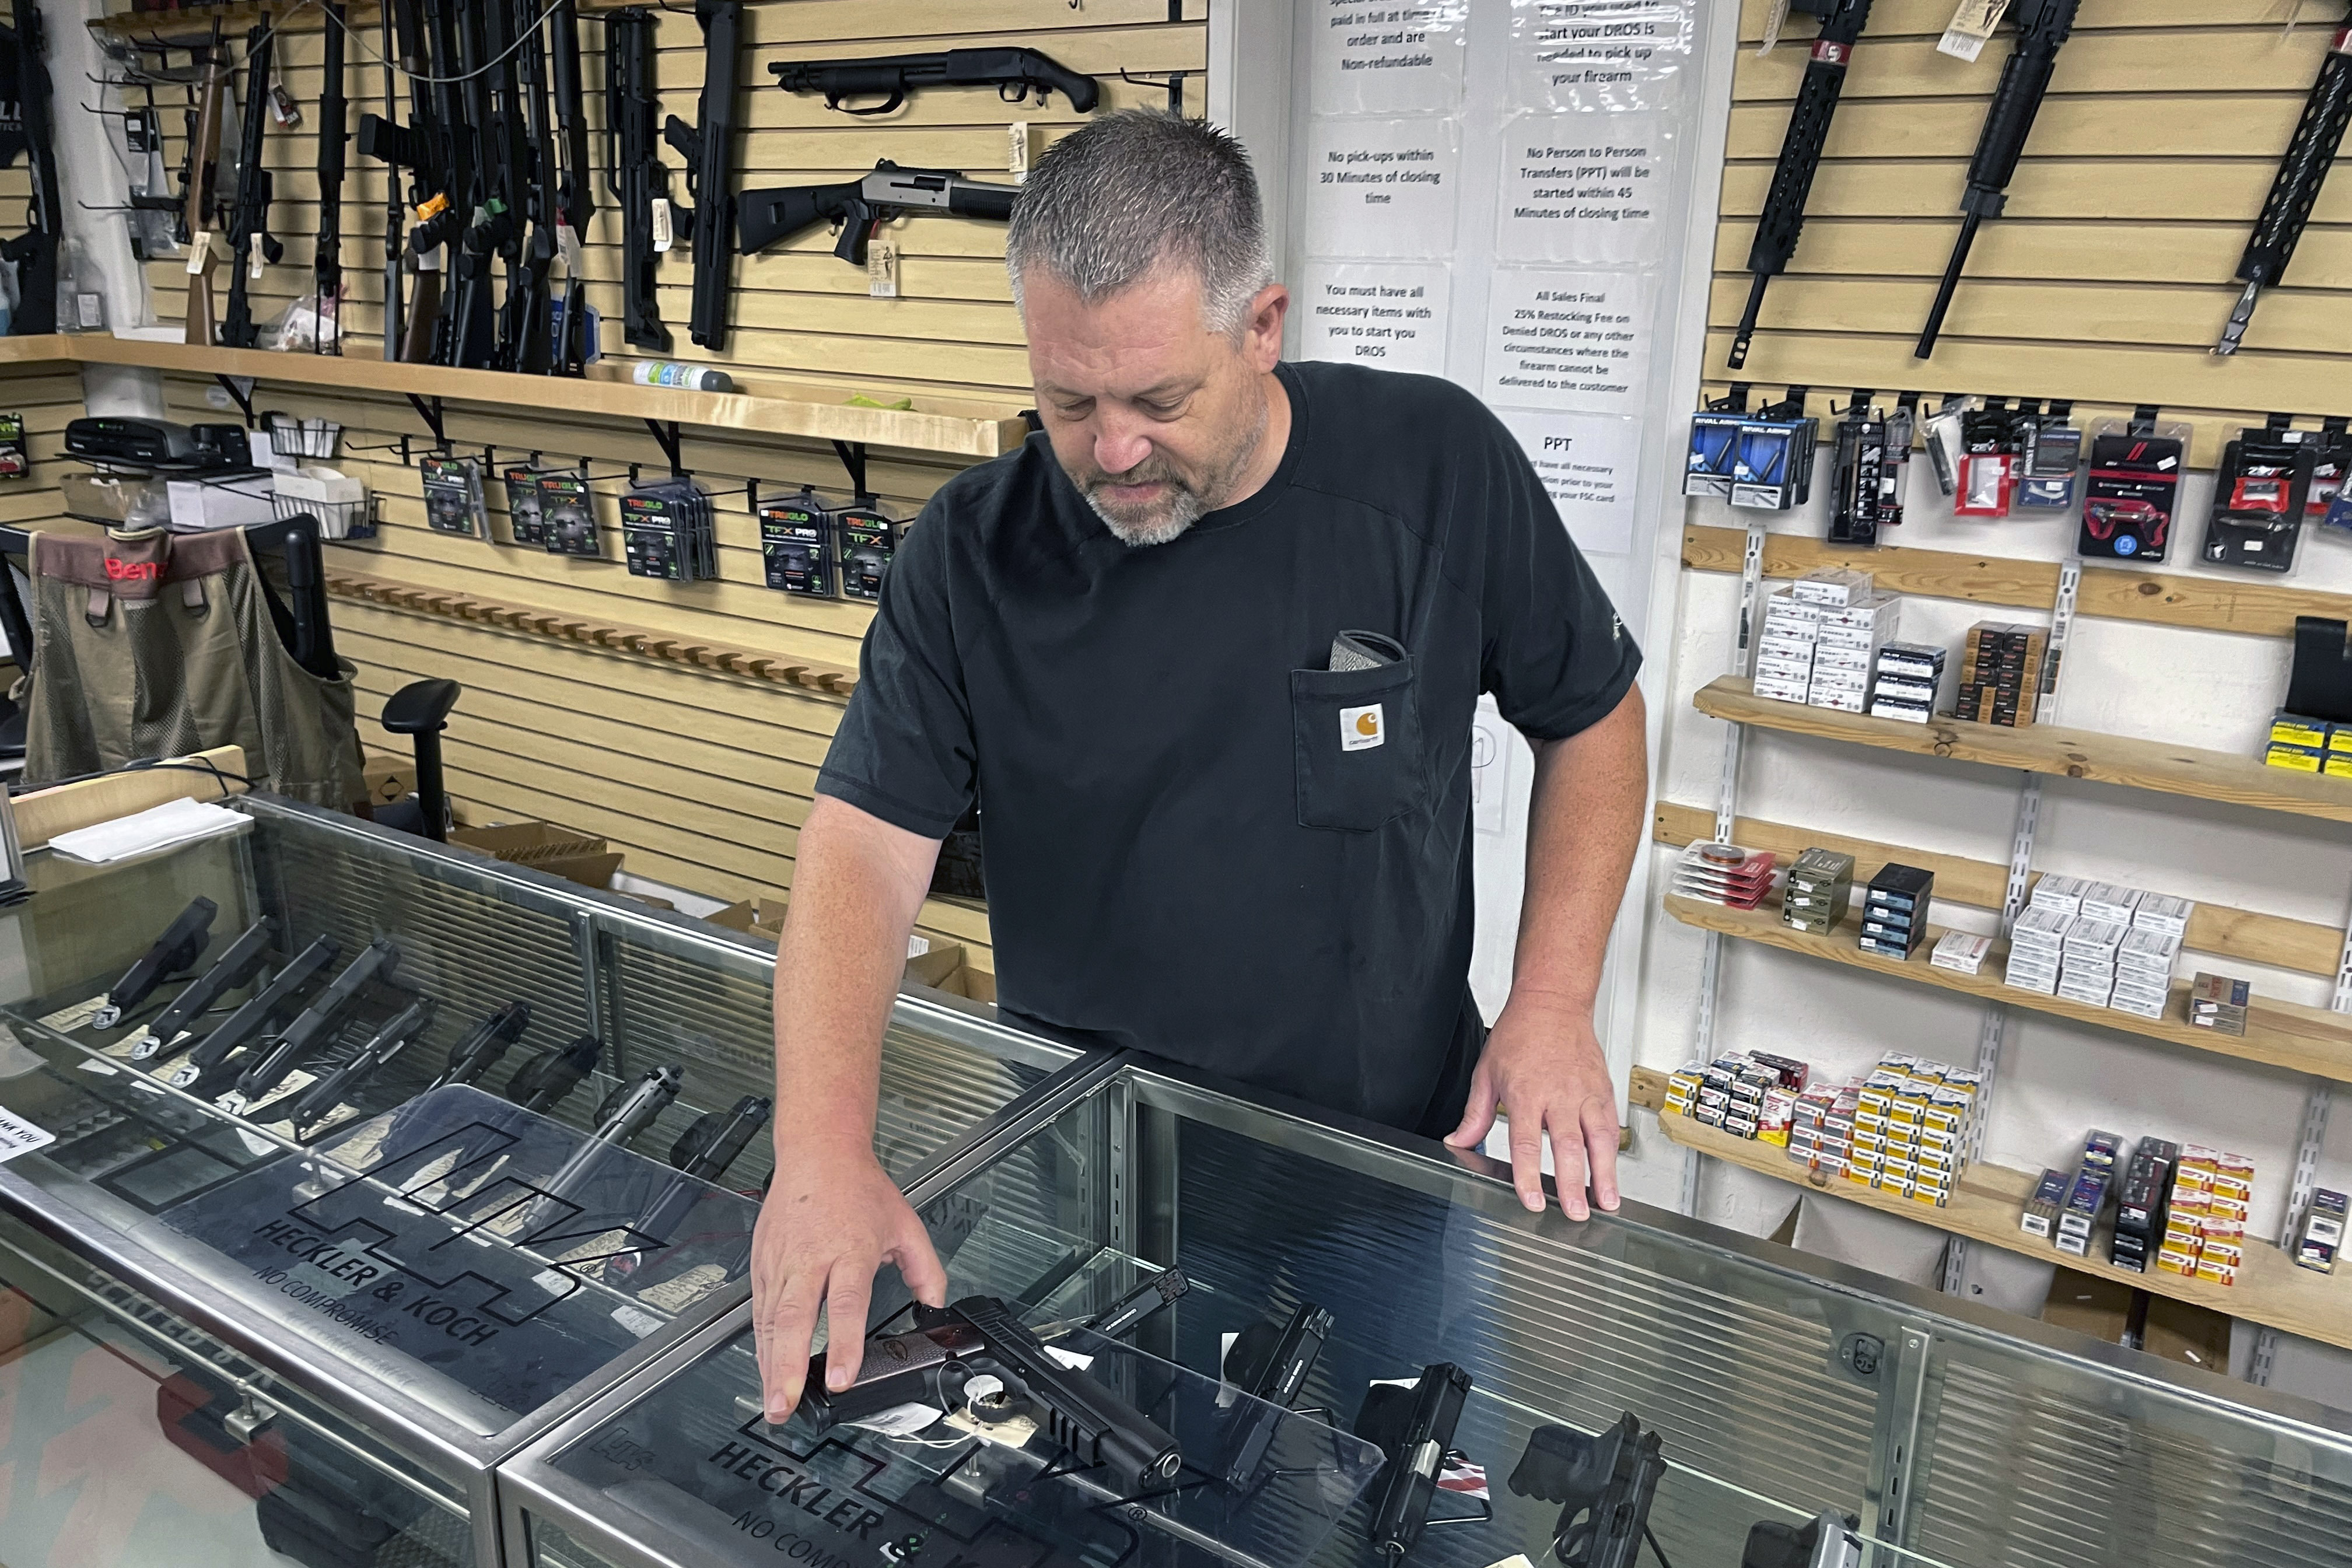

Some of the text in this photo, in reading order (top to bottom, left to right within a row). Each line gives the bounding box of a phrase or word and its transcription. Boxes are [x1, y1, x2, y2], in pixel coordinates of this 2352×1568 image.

[1331, 13, 1353, 28] paid
[1355, 14, 1364, 24] in
[1368, 12, 1385, 23] full
[1388, 11, 1398, 22] at
[1572, 27, 1600, 39] your
[1604, 23, 1640, 37] DROS
[1644, 22, 1654, 35] is
[1348, 32, 1424, 47] order and are
[1537, 48, 1584, 62] needed
[1605, 46, 1631, 60] pick
[1635, 48, 1651, 60] up
[1342, 53, 1433, 70] Non-refundable
[1552, 71, 1632, 86] your firearm
[1328, 149, 1434, 164] No pick-ups within
[1527, 146, 1647, 158] No Person to Person
[1321, 170, 1440, 185] 30 Minutes of closing
[1521, 166, 1650, 180] Transfers (PPT) will be
[1366, 192, 1391, 204] time
[1533, 187, 1632, 198] started within 45
[1514, 207, 1650, 221] Minutes of closing time
[1326, 285, 1424, 298] You must have all
[1535, 291, 1605, 302] All Sales Final
[1316, 305, 1432, 318] necessary items with
[1514, 309, 1535, 319] 25%
[1538, 310, 1592, 324] Restocking
[1595, 313, 1613, 323] Fee
[1328, 326, 1416, 340] you to start you
[1503, 326, 1537, 336] Denied
[1540, 328, 1567, 338] DROS
[1583, 331, 1604, 341] any
[1605, 331, 1634, 341] other
[1356, 345, 1385, 357] DROS
[1504, 343, 1629, 358] circumstances where the
[1520, 360, 1609, 374] firearm cannot be
[1499, 376, 1628, 393] delivered to the customer
[1544, 437, 1573, 451] PPT
[1572, 464, 1613, 475] necessary
[627, 499, 663, 510] TRUGLO
[652, 516, 671, 525] PRO
[769, 510, 808, 522] TRUGLO
[795, 527, 817, 538] PRO
[847, 532, 883, 545] TFX
[13, 1130, 41, 1143] YOU
[254, 1219, 499, 1346] HECKLER & KOCH
[253, 1266, 398, 1345] NO COMPROMISE
[708, 1441, 884, 1541] HECKLER
[732, 1511, 775, 1539] NO
